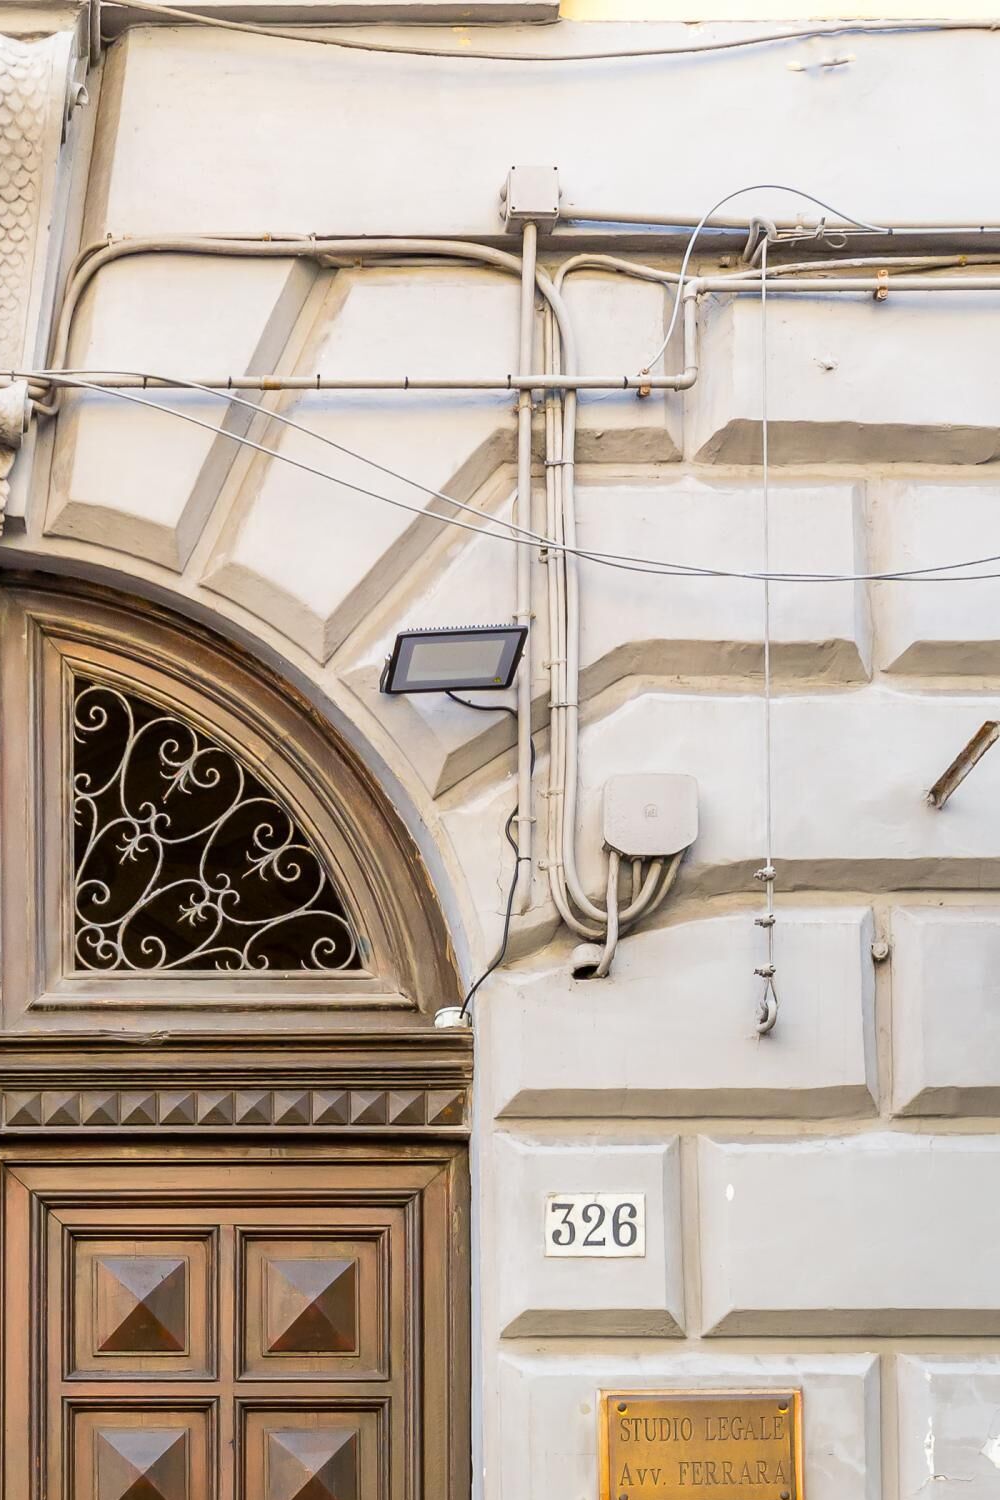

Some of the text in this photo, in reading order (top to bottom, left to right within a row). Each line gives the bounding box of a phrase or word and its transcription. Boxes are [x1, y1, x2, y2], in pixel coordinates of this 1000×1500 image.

[551, 1203, 637, 1247] 326
[619, 1416, 784, 1442] STUDIO LEGALE
[619, 1460, 788, 1486] Avv. FERRARA
